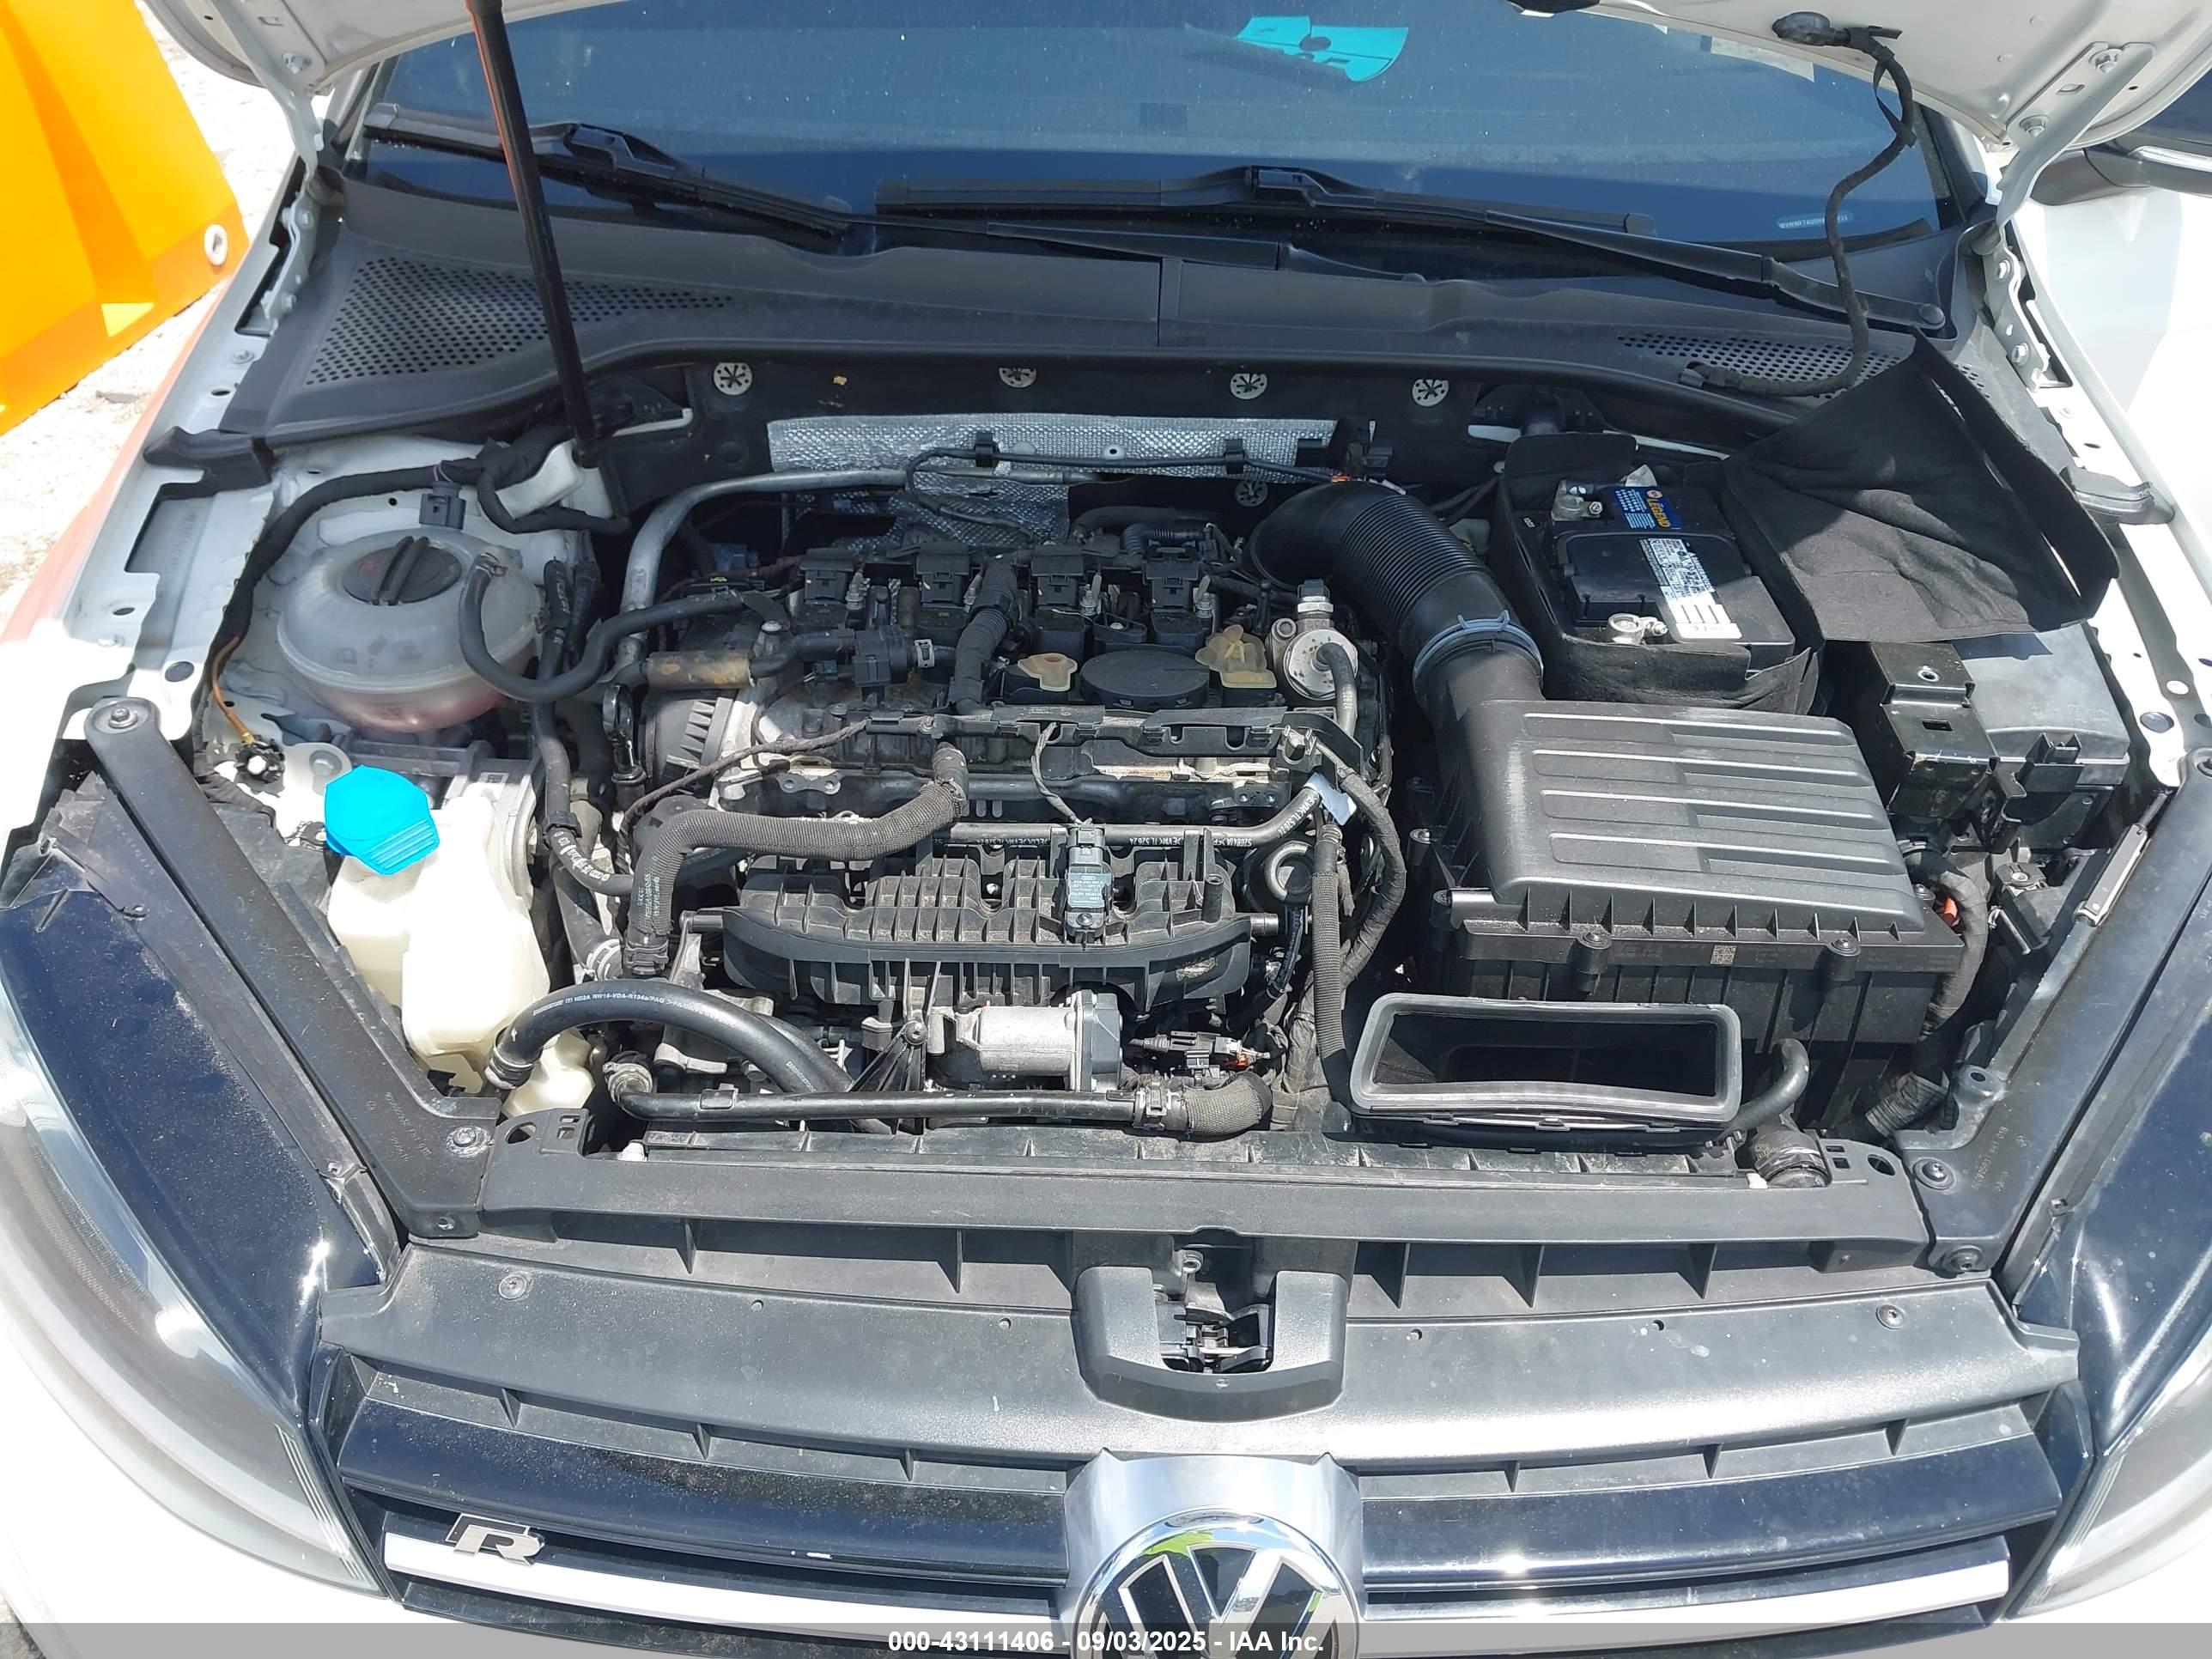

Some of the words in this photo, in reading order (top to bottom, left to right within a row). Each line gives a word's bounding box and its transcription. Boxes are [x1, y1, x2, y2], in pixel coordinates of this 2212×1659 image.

[1647, 498, 1671, 528] LEGEND
[786, 1060, 816, 1093] BRIDGESTON
[445, 1512, 546, 1565] R
